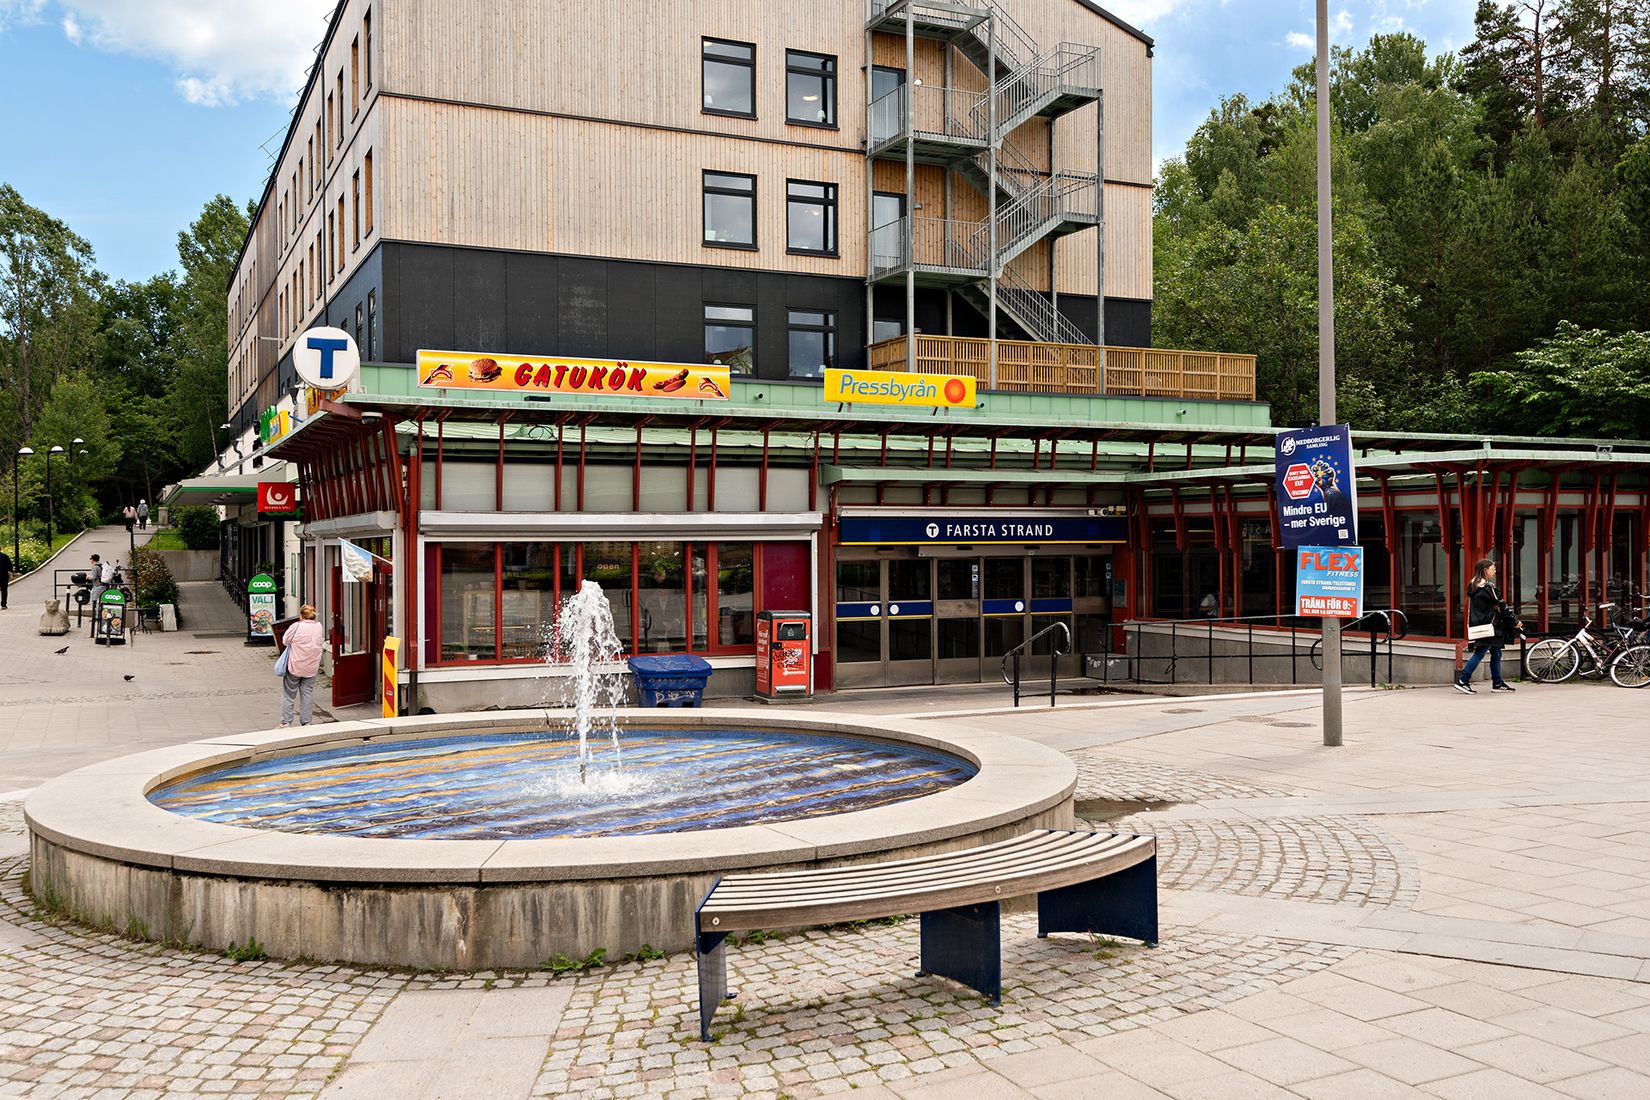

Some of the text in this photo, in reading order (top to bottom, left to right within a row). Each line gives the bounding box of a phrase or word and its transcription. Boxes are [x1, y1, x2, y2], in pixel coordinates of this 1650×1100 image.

[307, 337, 348, 379] T
[513, 361, 647, 393] GATUKÖK
[839, 373, 937, 402] Pressbyrån
[1296, 435, 1340, 446] MEDBORGERLIG
[1283, 503, 1327, 516] Mindre EU
[1290, 518, 1307, 529] mer
[1309, 515, 1346, 528] Sverige
[947, 524, 996, 537] FARSTA
[1002, 524, 1053, 537] STRAND
[1300, 552, 1359, 571] FLEX
[252, 581, 272, 589] coop
[1300, 597, 1326, 609] TRÄNA
[1326, 598, 1341, 609] FÖR
